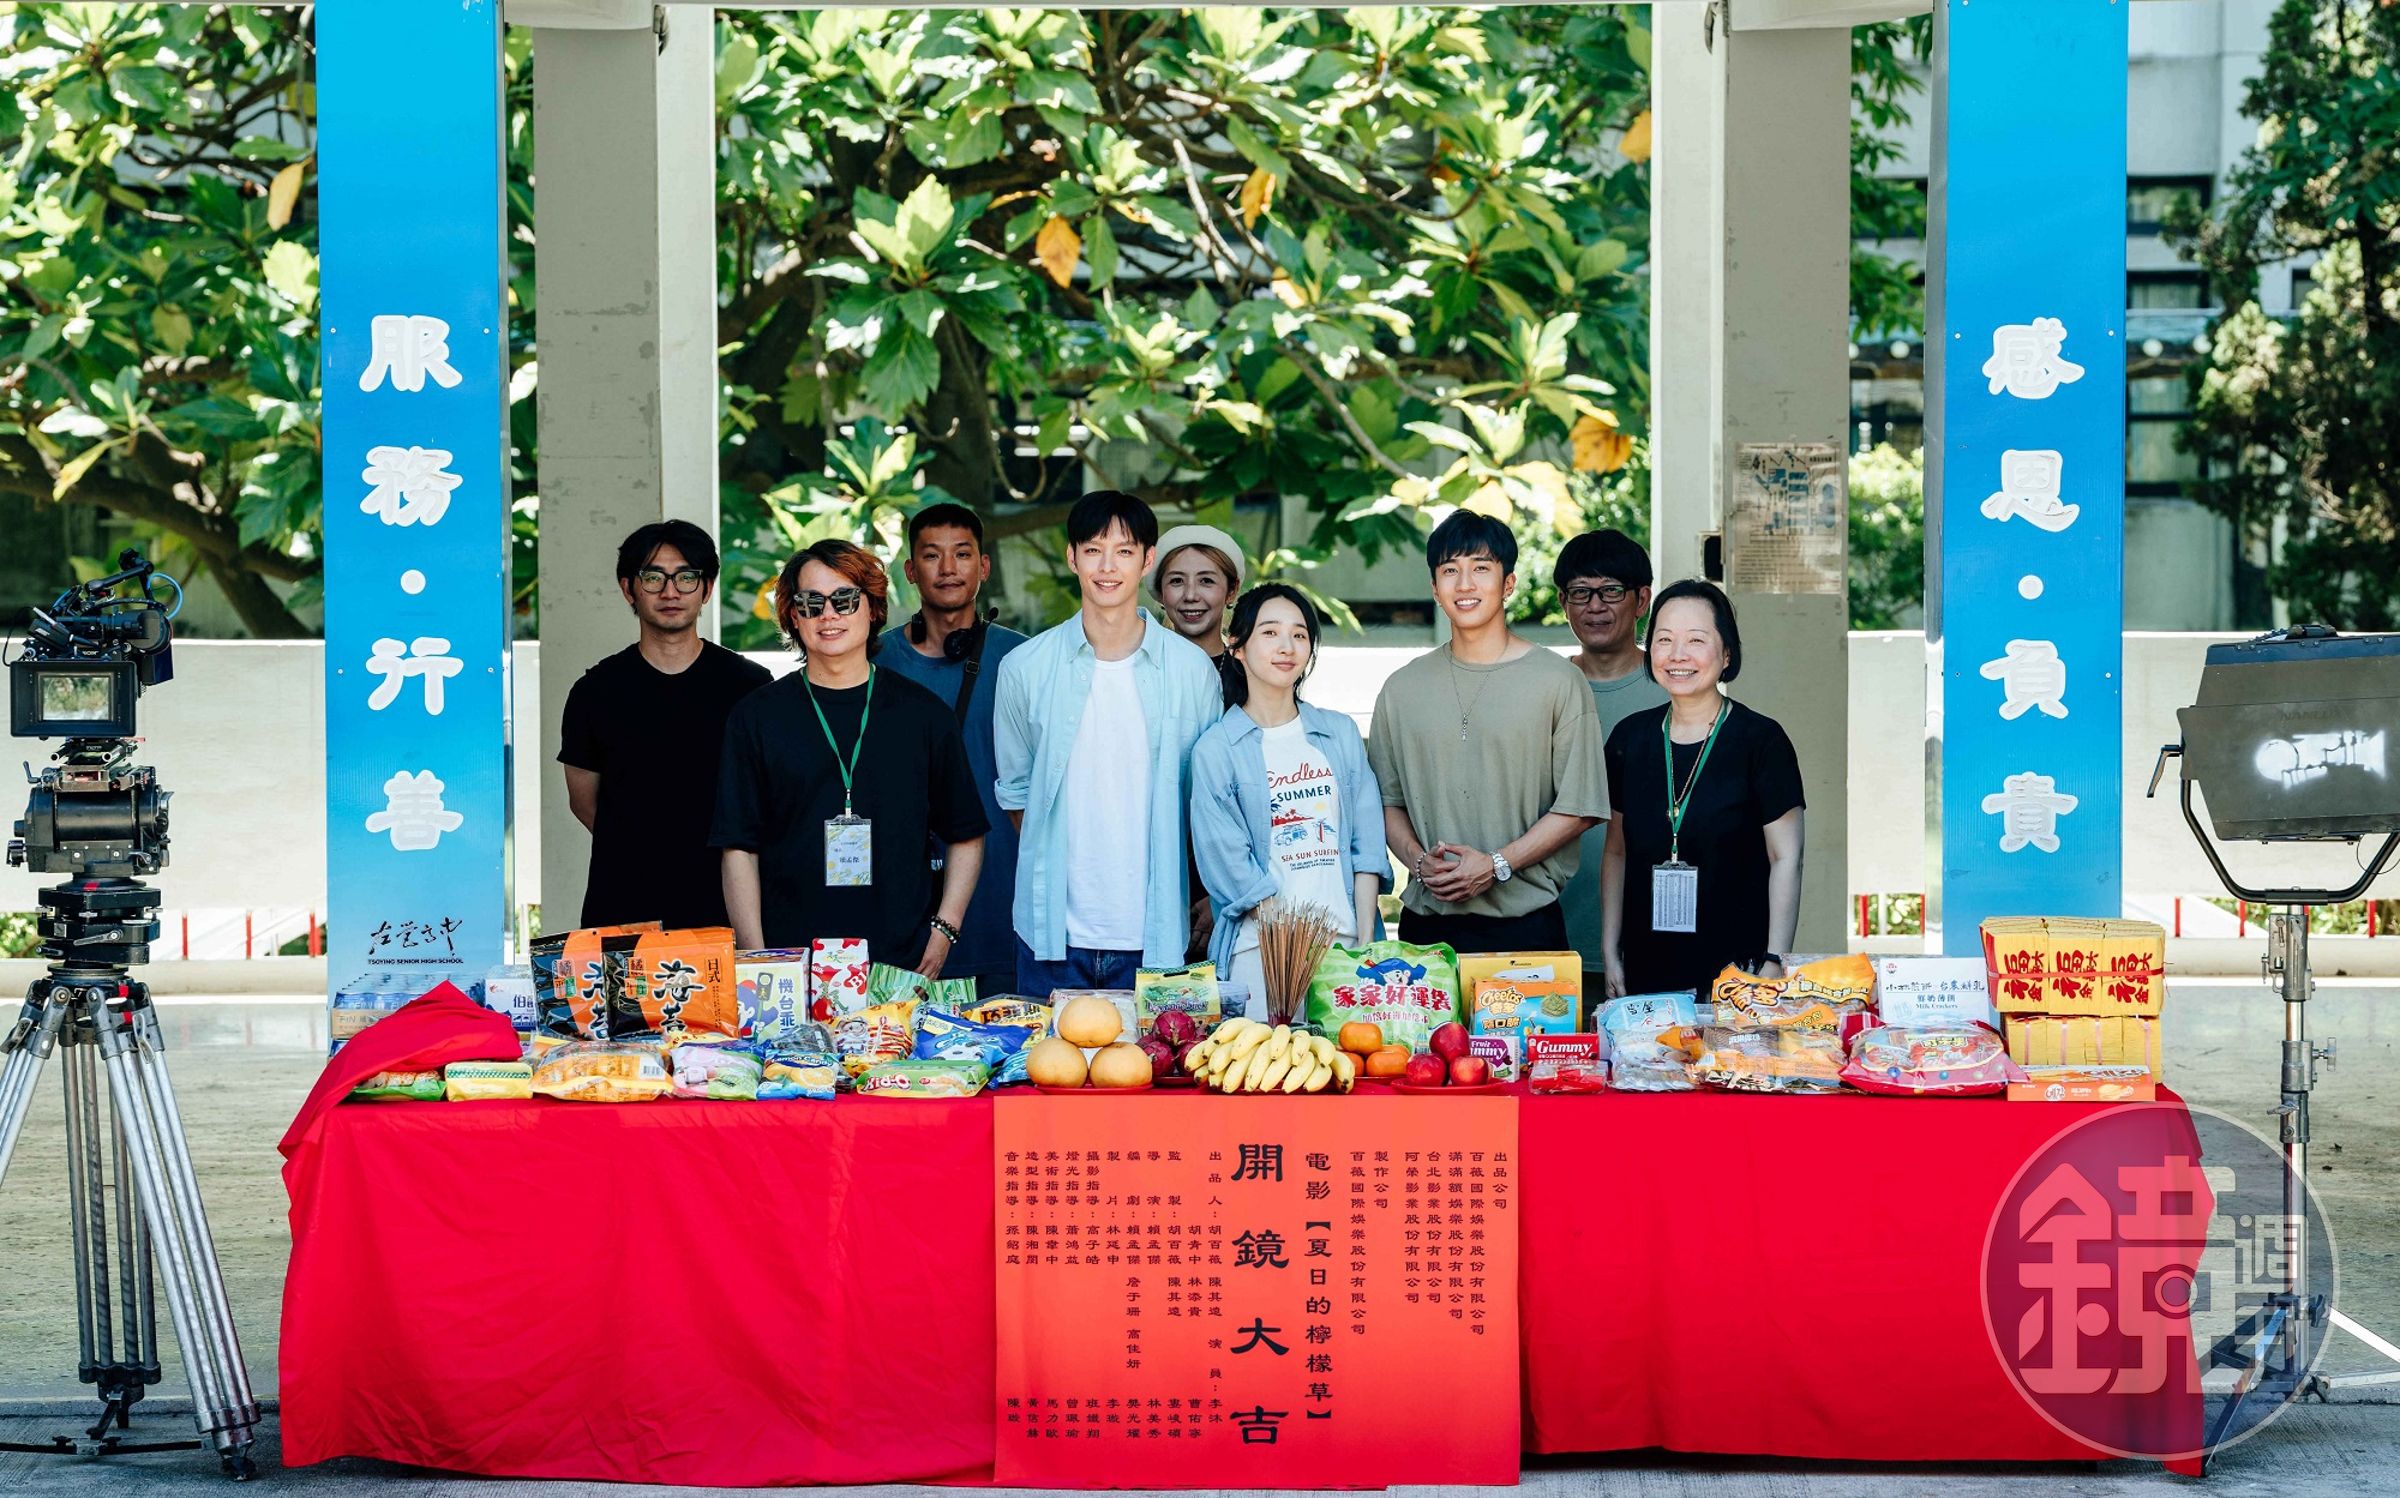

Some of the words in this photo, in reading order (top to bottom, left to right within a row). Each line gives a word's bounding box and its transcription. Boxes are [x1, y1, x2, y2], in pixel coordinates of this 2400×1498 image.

[1276, 785, 1332, 803] SUMMER
[1295, 851, 1312, 860] SUN
[707, 958, 721, 983] 日式
[778, 978, 796, 1033] 機台乖
[1333, 984, 1452, 1012] 家家好運袋
[1481, 988, 1524, 1007] Cheetos
[1470, 1047, 1507, 1060] ummy
[1536, 1040, 1593, 1056] Gummy
[1374, 1150, 1391, 1209] 製作公司
[1493, 1152, 1510, 1210] 出品公司
[1426, 1151, 1444, 1304] 台北影業股份有限公司
[1229, 1143, 1292, 1446] 開鏡大吉
[1304, 1152, 1335, 1420] 電影【夏日的檸檬草】
